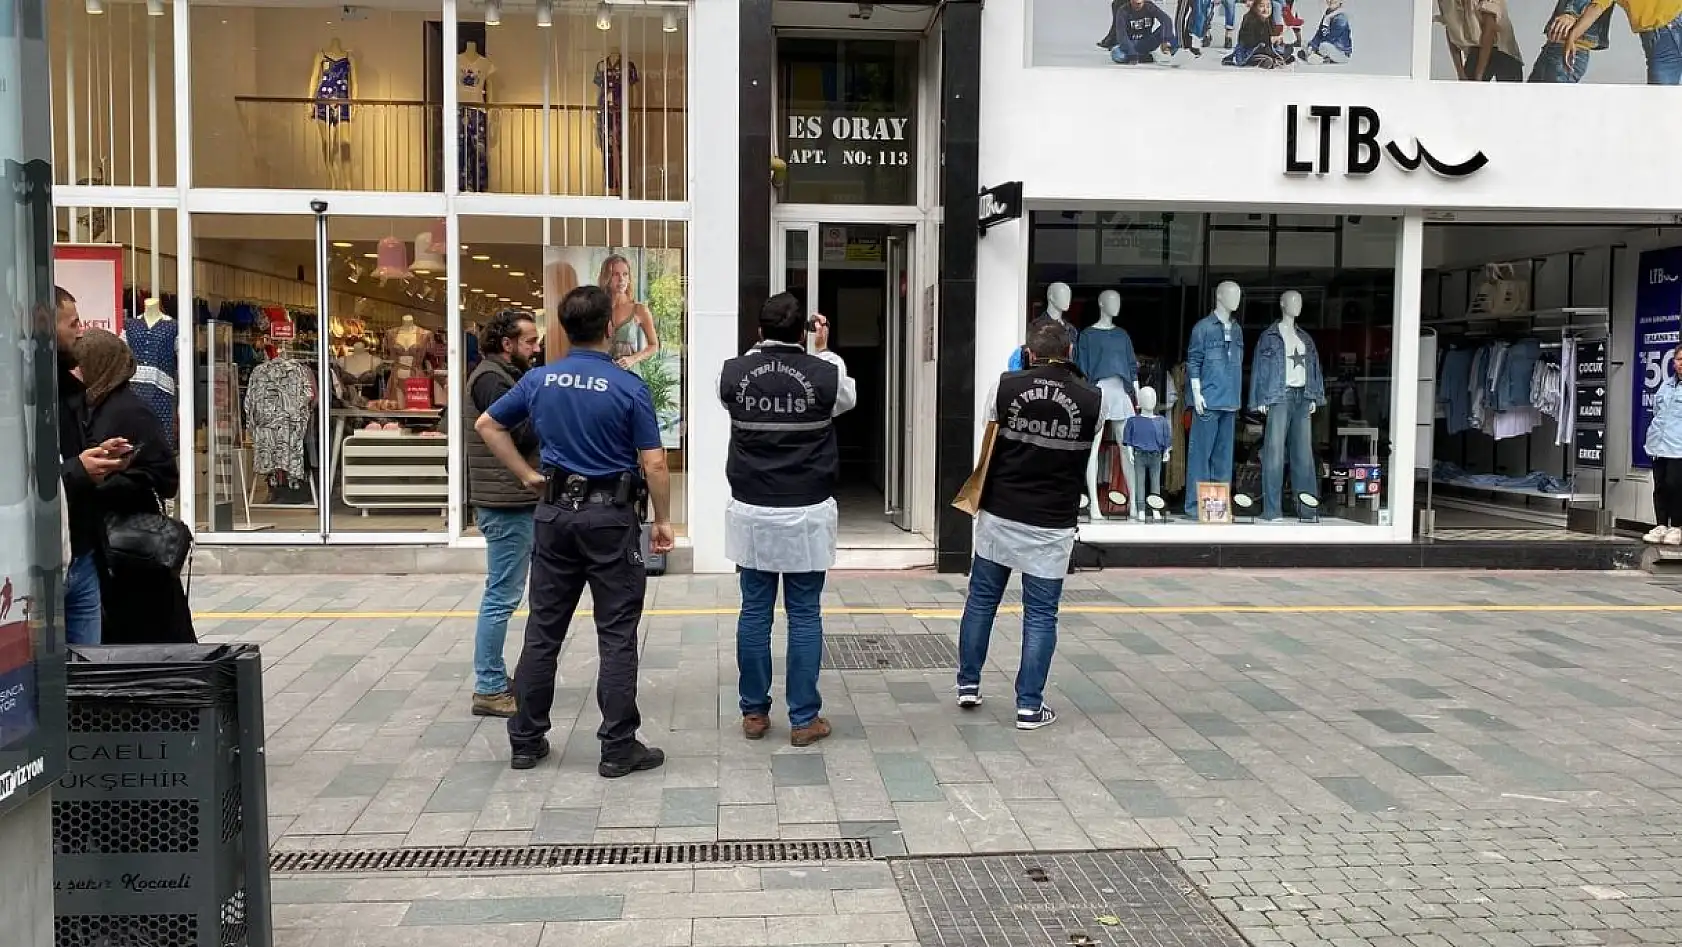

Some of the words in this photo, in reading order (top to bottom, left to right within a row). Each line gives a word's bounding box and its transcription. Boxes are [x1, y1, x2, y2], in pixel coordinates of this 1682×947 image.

[788, 115, 823, 139] ES
[832, 116, 908, 141] ORAY
[1286, 104, 1381, 174] LTB
[788, 149, 827, 164] APT.
[842, 150, 873, 165] NO:
[879, 151, 909, 165] 113
[745, 391, 807, 414] POLİS
[1016, 417, 1068, 439] POLİS
[1579, 449, 1601, 460] ERKEK
[121, 873, 192, 893] Kocaeli
